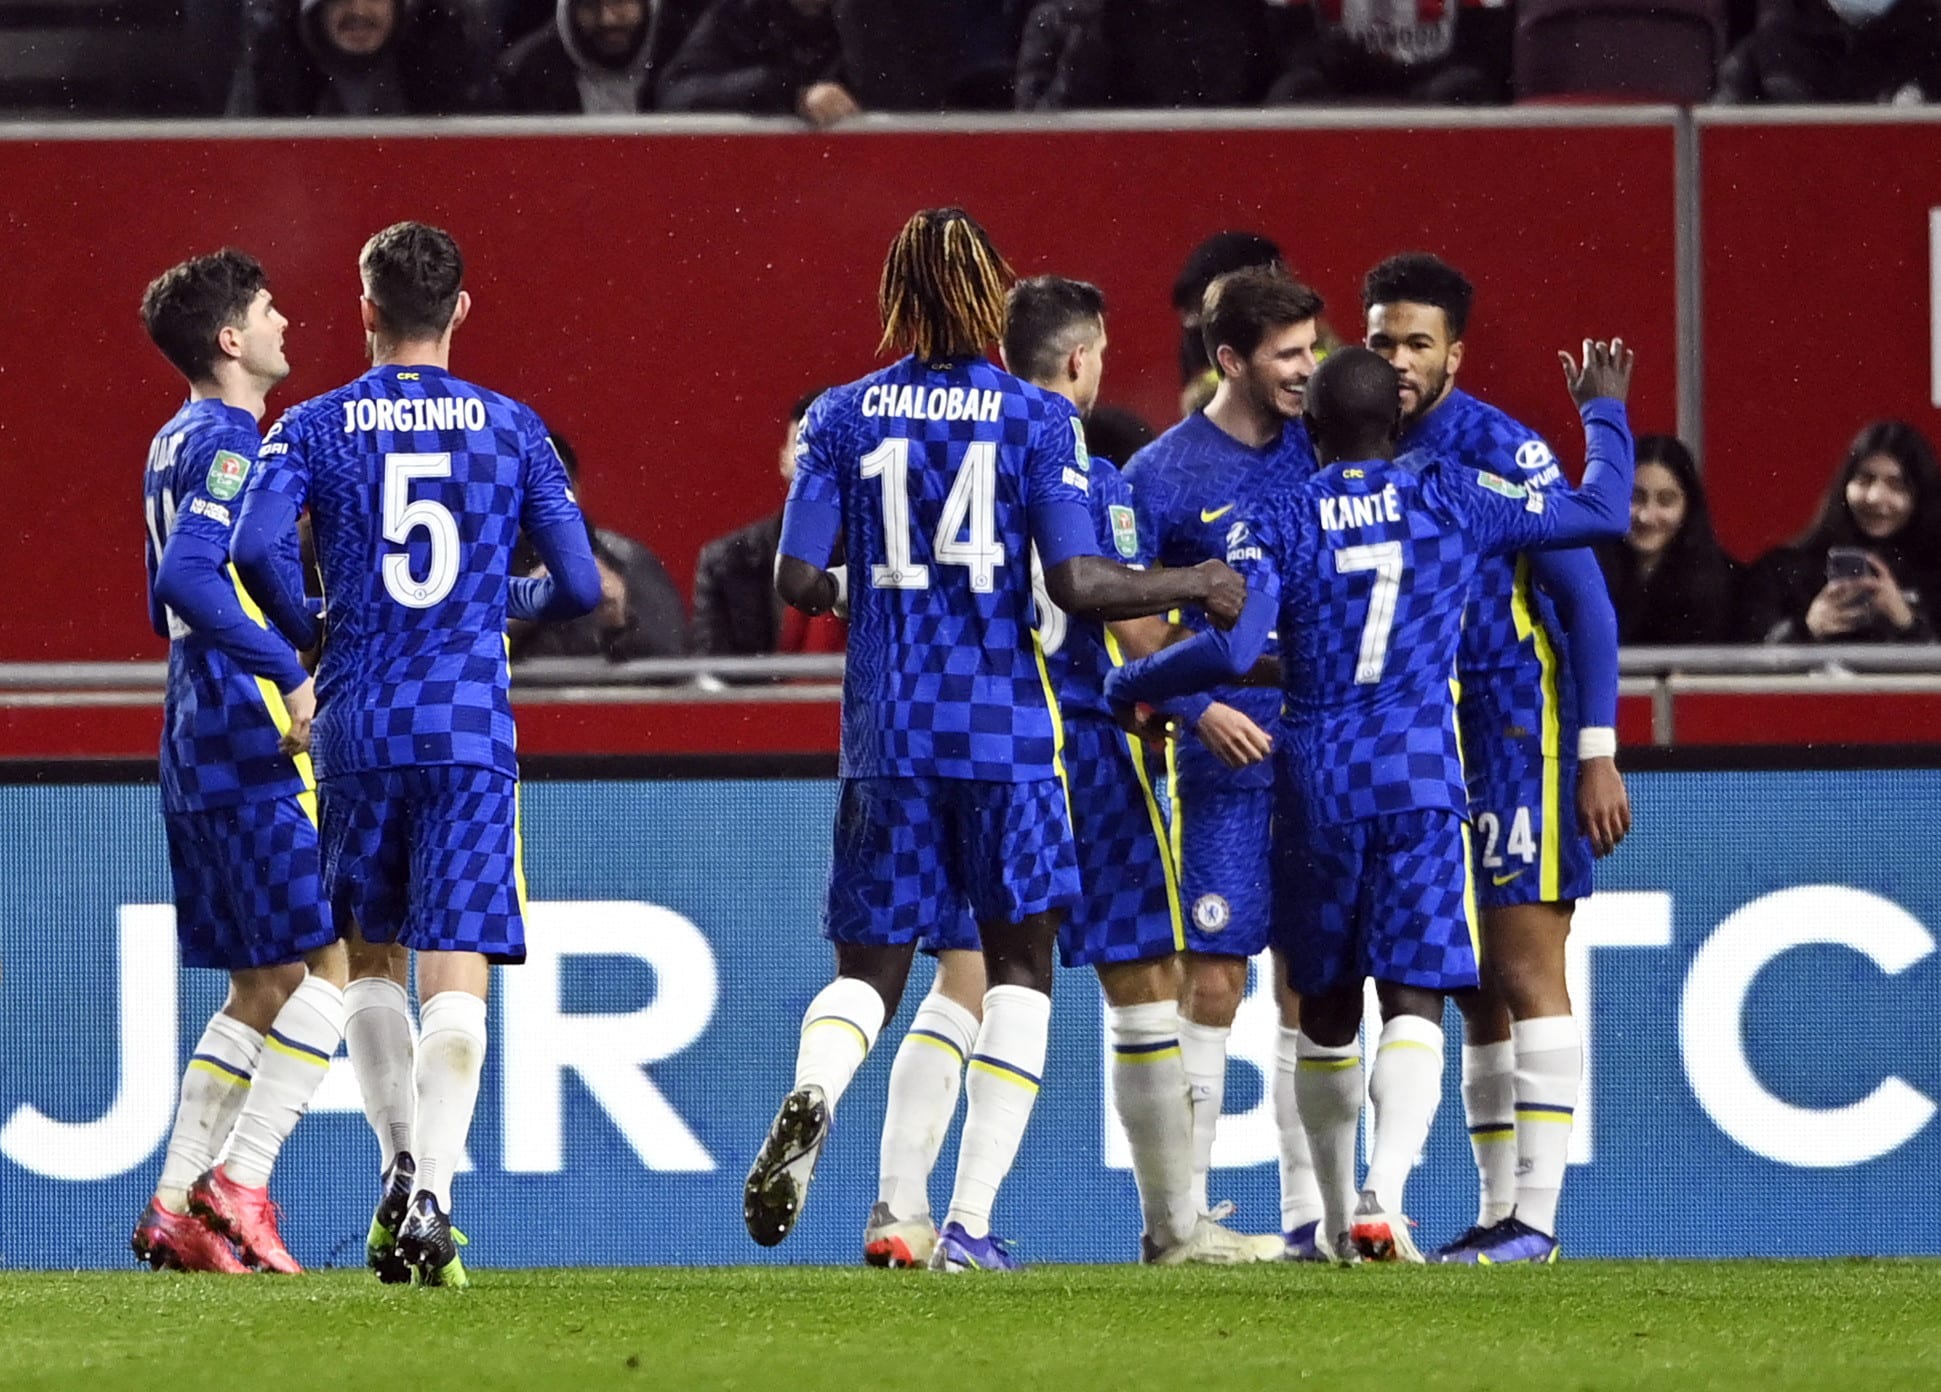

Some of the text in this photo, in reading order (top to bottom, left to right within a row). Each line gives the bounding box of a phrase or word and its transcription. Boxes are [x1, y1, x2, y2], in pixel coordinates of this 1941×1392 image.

[396, 372, 420, 380] CFC
[343, 397, 486, 432] JORGINHO
[861, 384, 1002, 422] CHALOBAH
[1342, 469, 1364, 478] CFC
[382, 452, 460, 609] 5
[860, 437, 1005, 593] 14
[1320, 483, 1401, 531] KANTÉ
[1335, 541, 1403, 685] 7
[1478, 807, 1537, 868] 24
